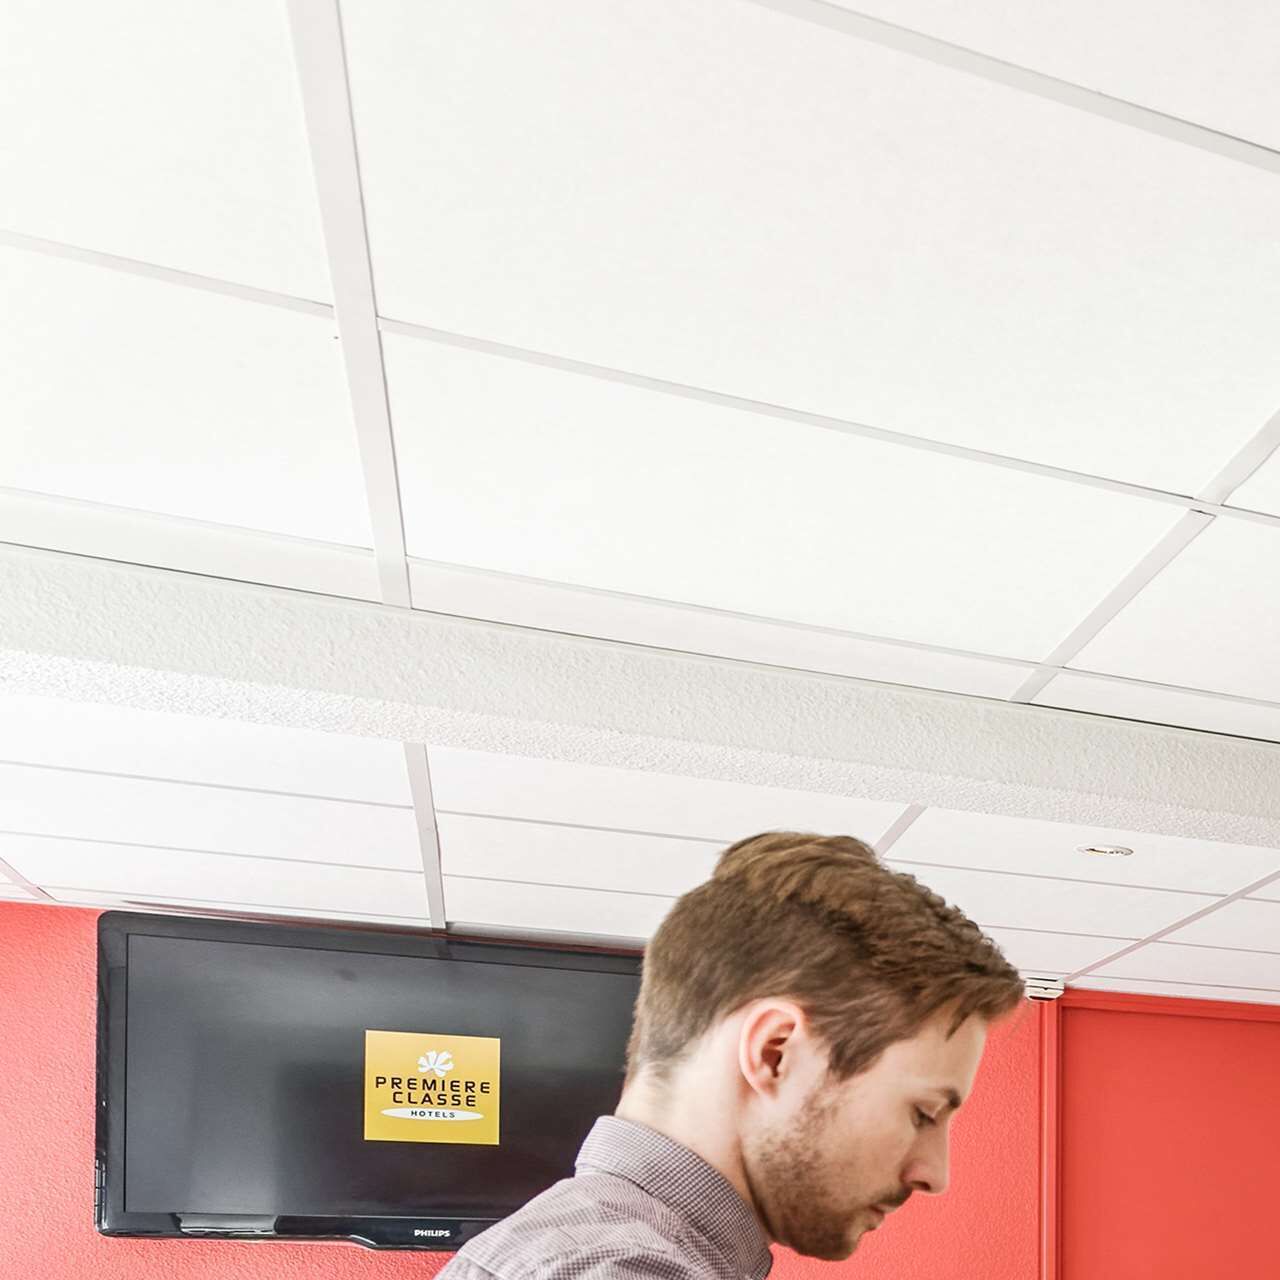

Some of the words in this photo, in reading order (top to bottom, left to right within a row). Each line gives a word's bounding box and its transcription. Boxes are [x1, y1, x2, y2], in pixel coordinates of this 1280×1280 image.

[375, 1076, 491, 1094] PREMIERE
[392, 1091, 477, 1107] CLASSE
[410, 1110, 456, 1118] HOTELS
[414, 1229, 451, 1237] PHILIPS
